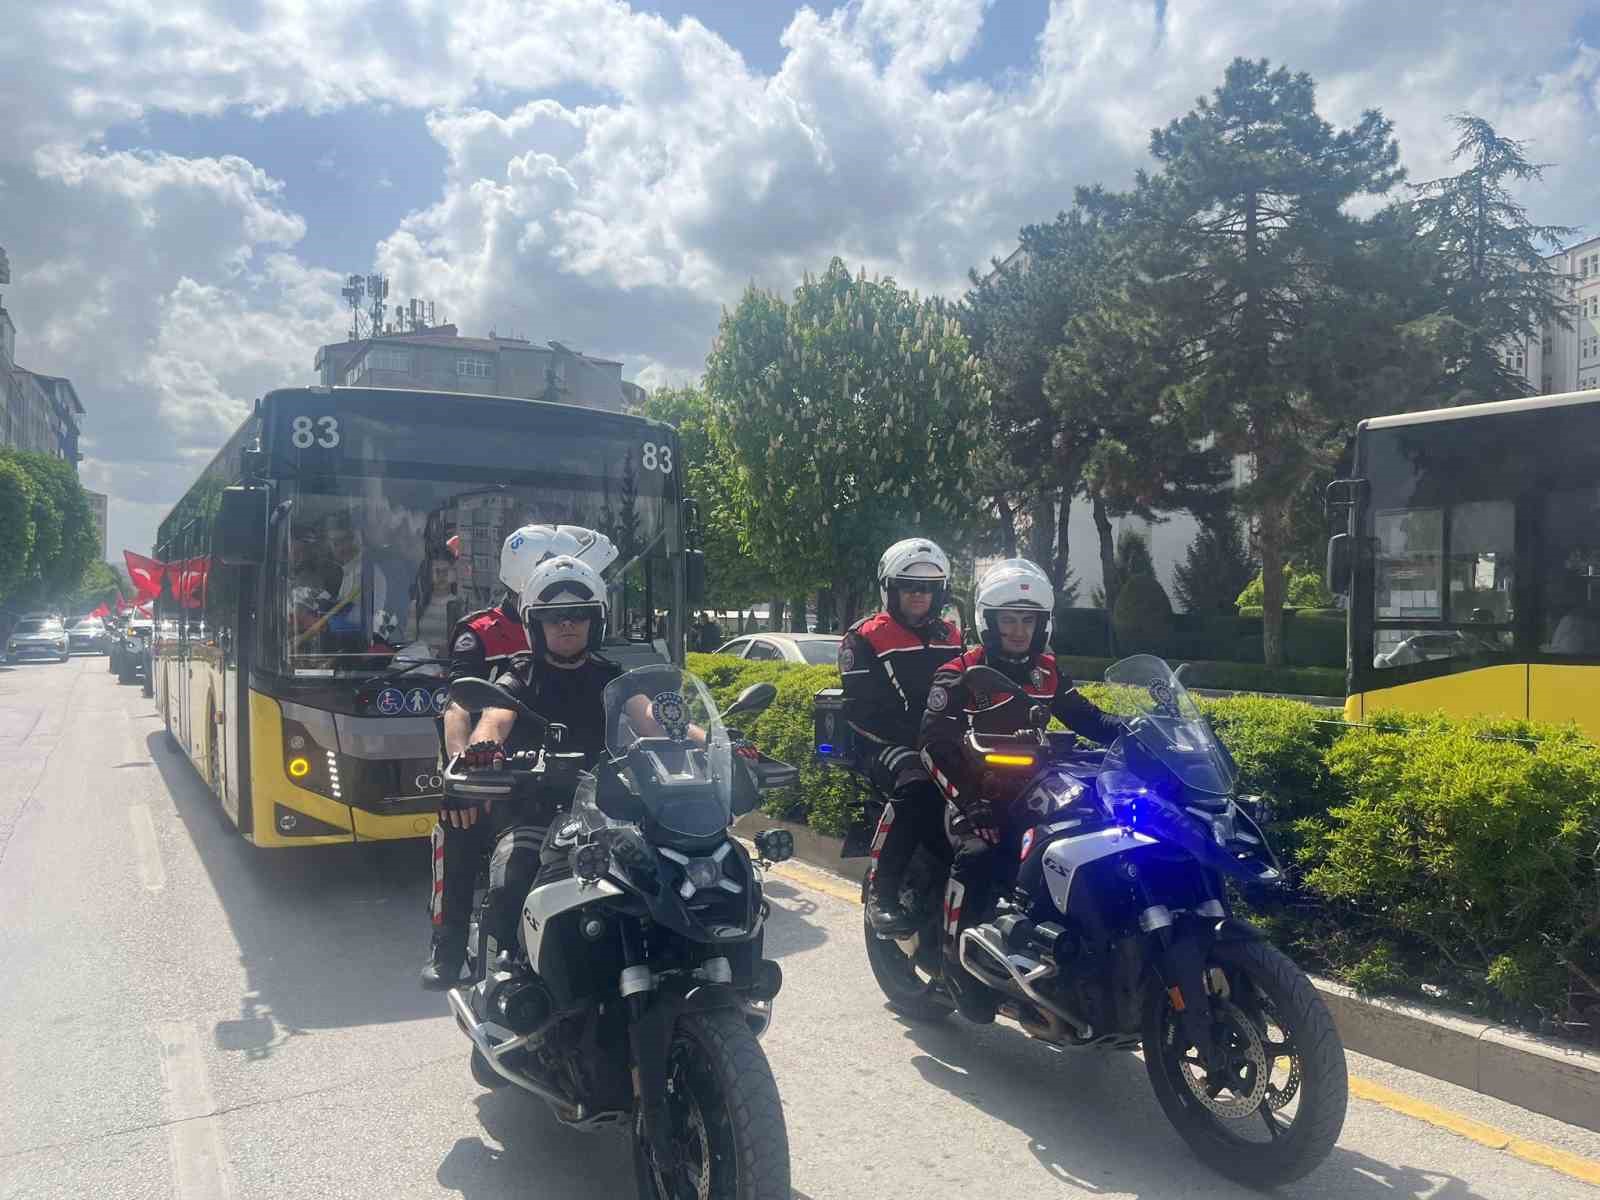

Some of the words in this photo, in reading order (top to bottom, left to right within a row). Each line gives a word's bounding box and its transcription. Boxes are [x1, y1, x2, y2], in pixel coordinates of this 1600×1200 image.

[292, 415, 340, 448] 83
[642, 441, 673, 474] 83
[415, 774, 442, 792] ÇO
